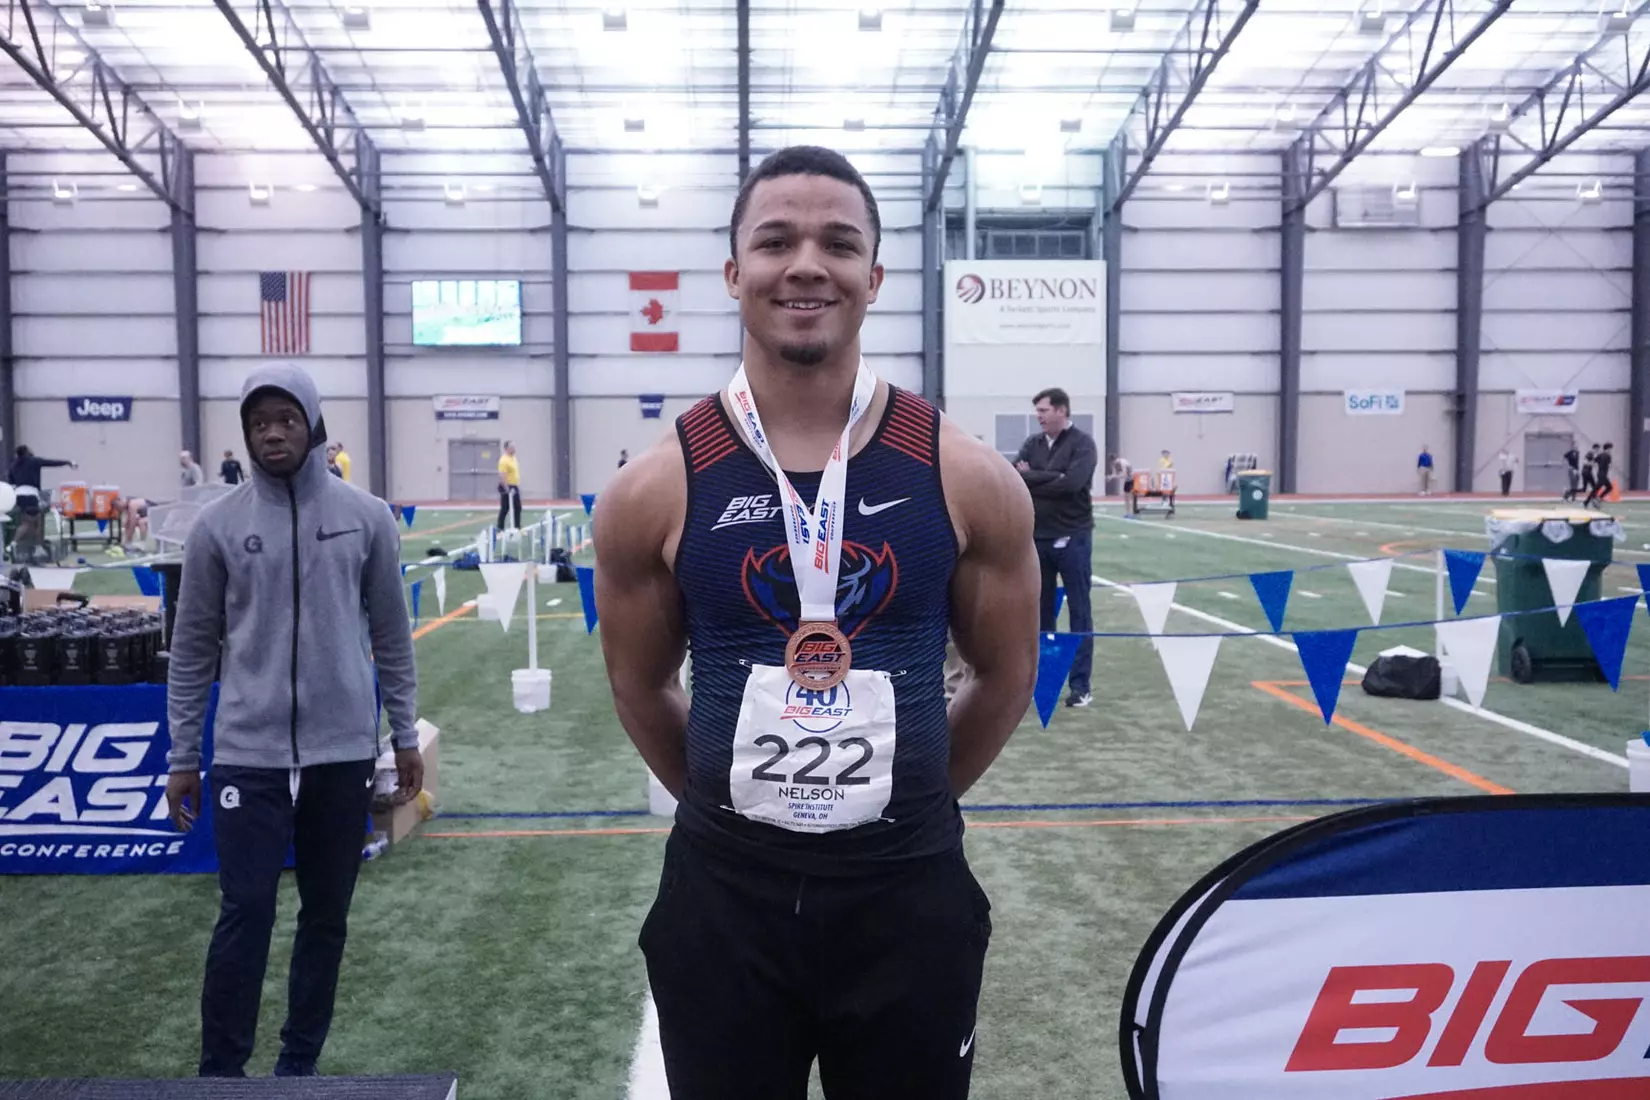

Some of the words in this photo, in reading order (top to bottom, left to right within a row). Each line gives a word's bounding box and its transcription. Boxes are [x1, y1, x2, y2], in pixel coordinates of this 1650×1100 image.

[990, 277, 1097, 300] BEYNON
[76, 399, 125, 419] Jeep
[1349, 395, 1382, 409] SoFi
[726, 494, 773, 511] BIG
[716, 506, 782, 524] EAST
[801, 642, 837, 653] BIG
[795, 653, 846, 663] EAST
[0, 721, 159, 773] BIG
[752, 734, 874, 786] 222
[220, 785, 241, 809] G
[778, 787, 845, 801] NELSON
[793, 812, 817, 820] GENEVA,
[805, 803, 834, 811] INSTITUTE
[0, 840, 185, 858] CONFERENCE
[1284, 955, 1650, 1072] BIG
